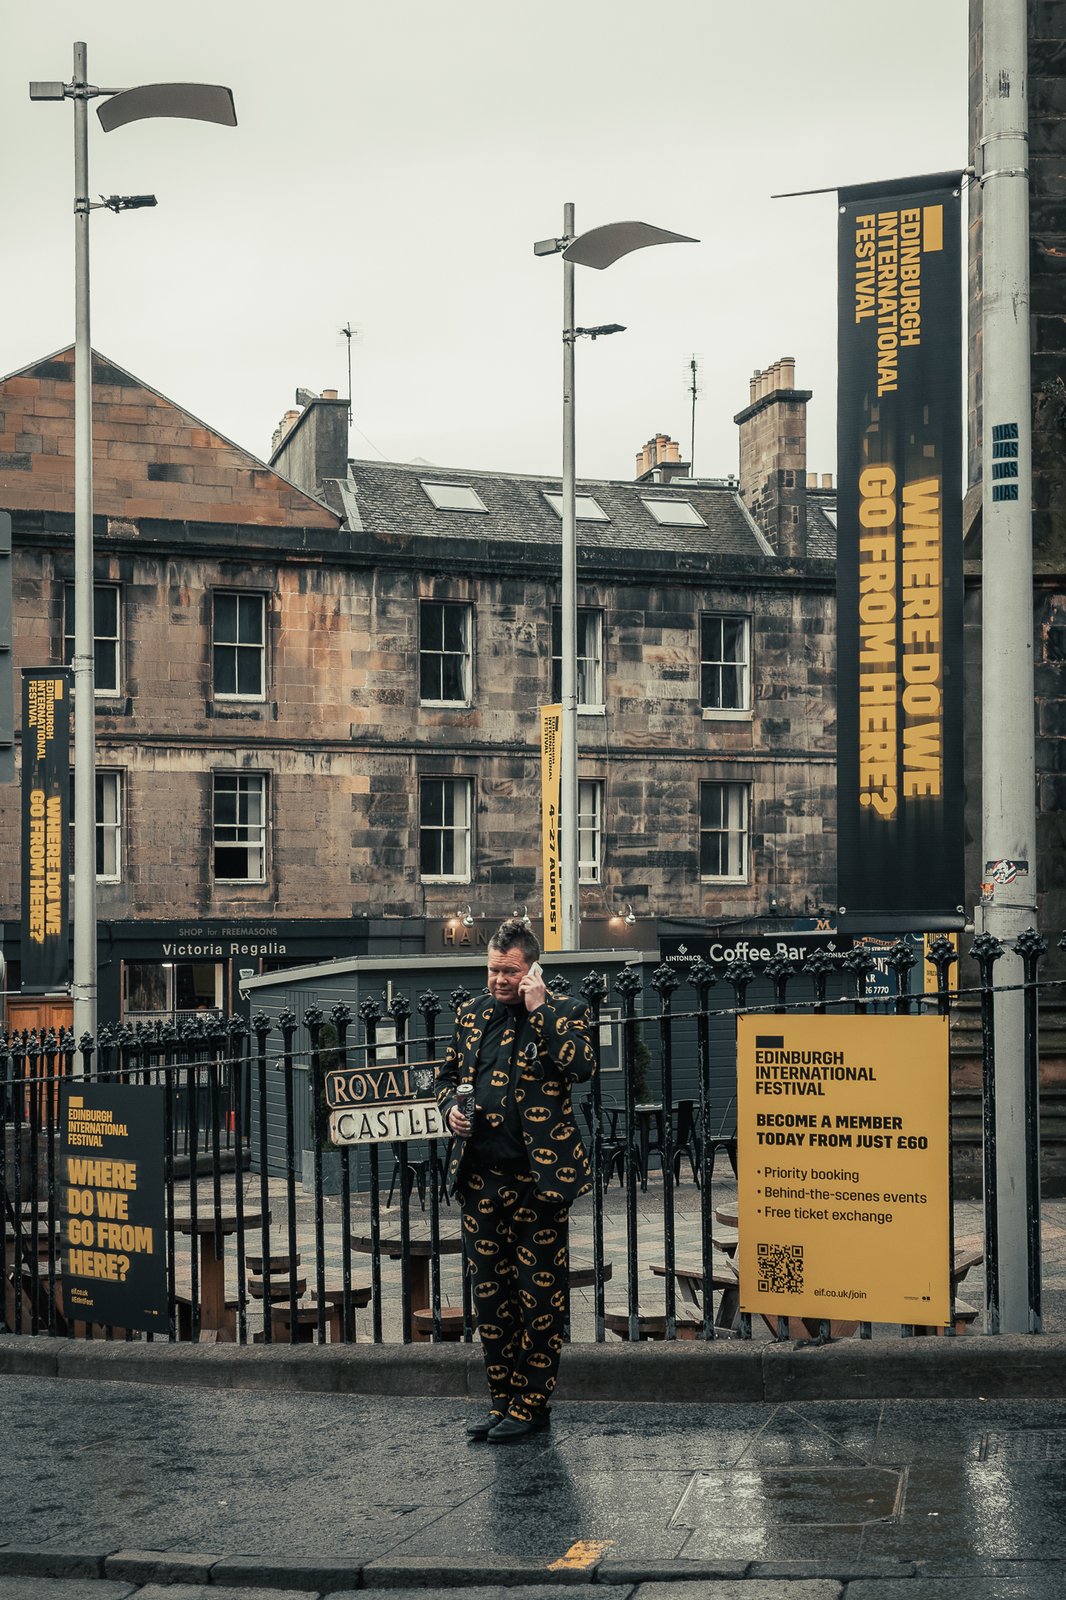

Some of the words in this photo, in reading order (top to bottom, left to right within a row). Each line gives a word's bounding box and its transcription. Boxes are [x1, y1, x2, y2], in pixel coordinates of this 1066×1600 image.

[856, 214, 876, 324] FESTIVAL
[900, 208, 920, 346] EDINBURGH
[878, 211, 898, 397] INTERNATIONAL
[859, 467, 896, 528] GO
[902, 479, 940, 644] WHERE
[859, 537, 896, 663] FROM
[902, 653, 940, 715] DO
[28, 680, 37, 728] FESTIVAL
[37, 680, 46, 760] INTERNATIONAL
[46, 680, 54, 740] EDINBURGH
[859, 673, 897, 815] HERE?
[903, 722, 940, 797] WE
[30, 790, 45, 817] GO
[30, 820, 45, 876] FROM
[46, 797, 61, 868] WHERE
[46, 871, 61, 900] DO
[30, 879, 45, 944] HERE?
[46, 901, 61, 935] WE
[178, 928, 203, 936] SHOP
[207, 928, 218, 936] for
[222, 927, 278, 936] FREEMASONS
[162, 944, 222, 956] Victoria
[230, 943, 286, 956] Regalia
[710, 942, 770, 962] Coffee
[776, 943, 806, 960] Bar
[874, 986, 890, 994] 7770
[756, 1051, 844, 1065] EDINBURGH
[756, 1066, 876, 1081] INTERNATIONAL
[334, 1070, 418, 1103] ROYAL
[756, 1082, 825, 1096] FESTIVAL
[68, 1108, 112, 1122] EDINBURGH
[68, 1121, 128, 1136] INTERNATIONAL
[338, 1107, 449, 1140] CASTLE
[756, 1114, 817, 1128] BECOME
[820, 1115, 832, 1128] A
[836, 1115, 902, 1130] MEMBER
[68, 1134, 103, 1147] FESTIVAL
[756, 1132, 805, 1146] TODAY
[809, 1134, 852, 1148] FROM
[856, 1134, 892, 1149] JUST
[897, 1136, 928, 1150] £60
[68, 1158, 137, 1190] WHERE
[764, 1167, 808, 1182] Priority
[811, 1168, 860, 1183] booking
[68, 1189, 94, 1217] DO
[98, 1192, 128, 1220] WE
[764, 1186, 880, 1202] Behind-the-scenes
[883, 1192, 928, 1204] events
[764, 1206, 791, 1218] Free
[794, 1207, 829, 1220] ticket
[832, 1209, 893, 1224] exchange
[68, 1219, 95, 1247] GO
[98, 1222, 153, 1254] FROM
[69, 1248, 130, 1282] HERE?
[814, 1288, 867, 1300] eif.co.uk/join
